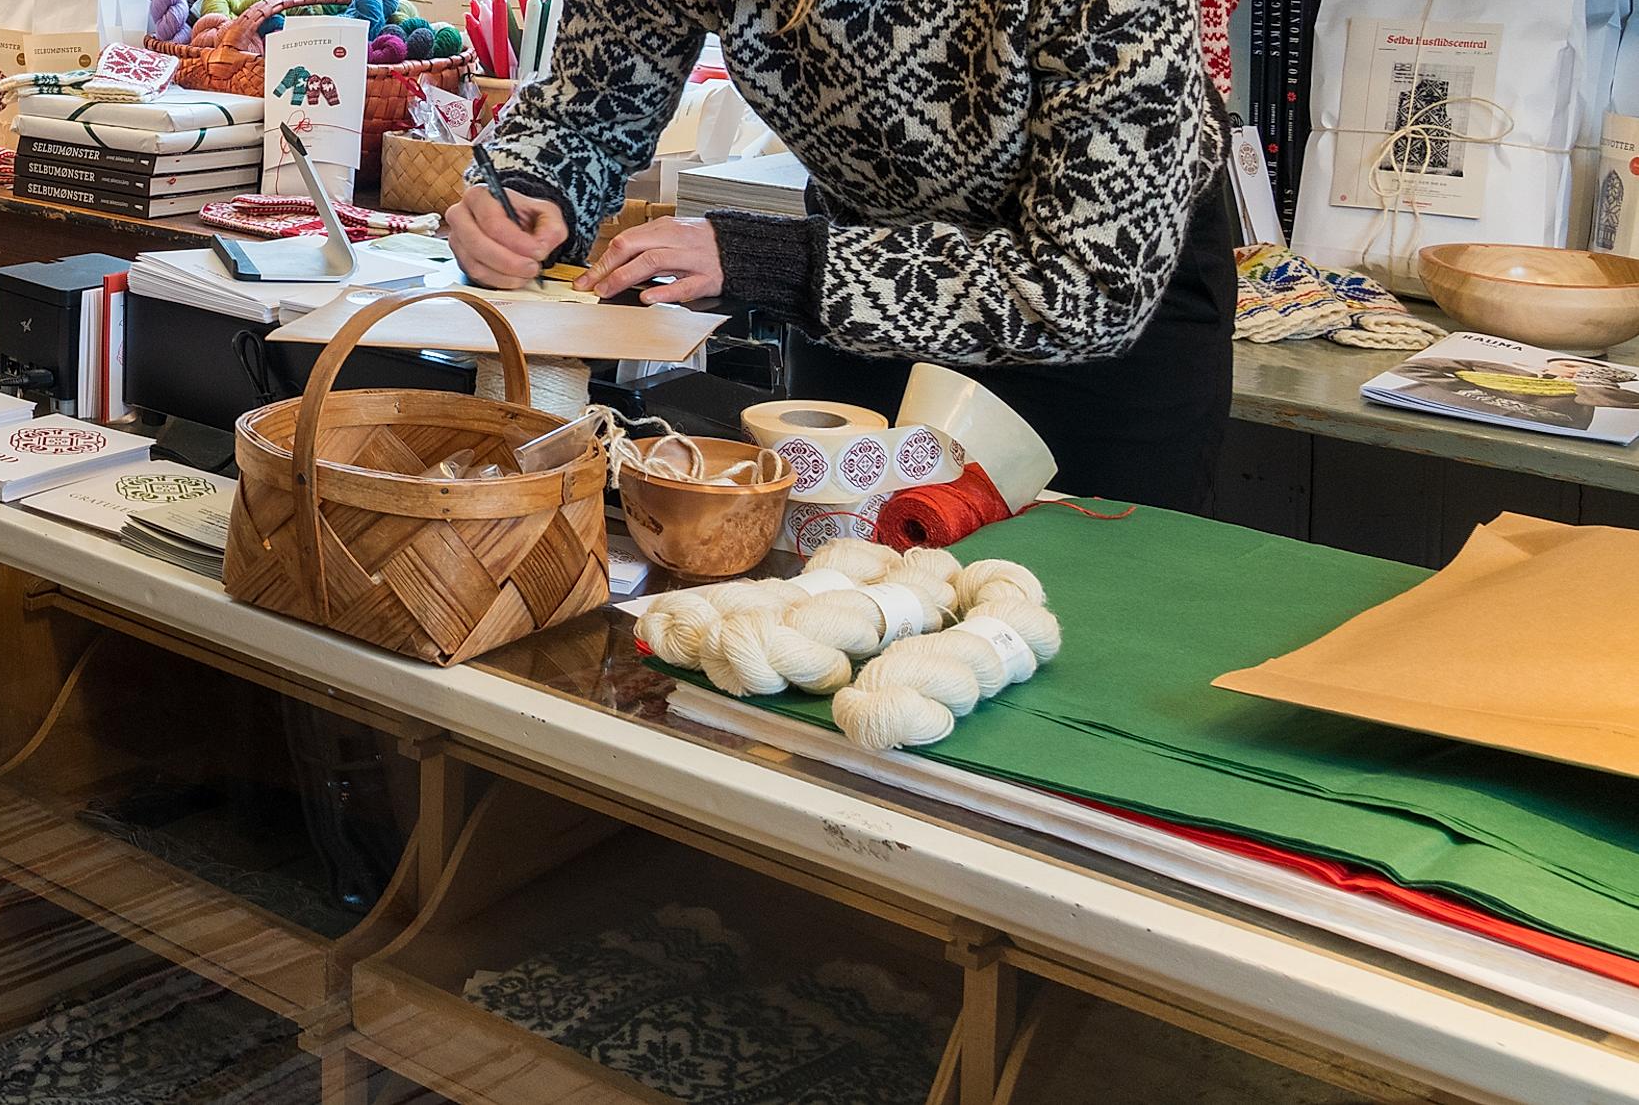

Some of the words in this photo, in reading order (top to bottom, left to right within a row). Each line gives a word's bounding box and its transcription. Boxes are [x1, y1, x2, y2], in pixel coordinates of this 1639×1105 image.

[281, 38, 333, 50] SELBUVOTTER
[1386, 34, 1414, 45] Selbu
[34, 46, 82, 55] SELBUMØNSTER
[1287, 51, 1299, 84] FLOR
[31, 141, 100, 161] SELBUMØNSTER
[28, 162, 96, 182] SELBUMØNSTER
[27, 182, 95, 204] SELBUMØNSTER
[1462, 334, 1523, 352] RAUMA
